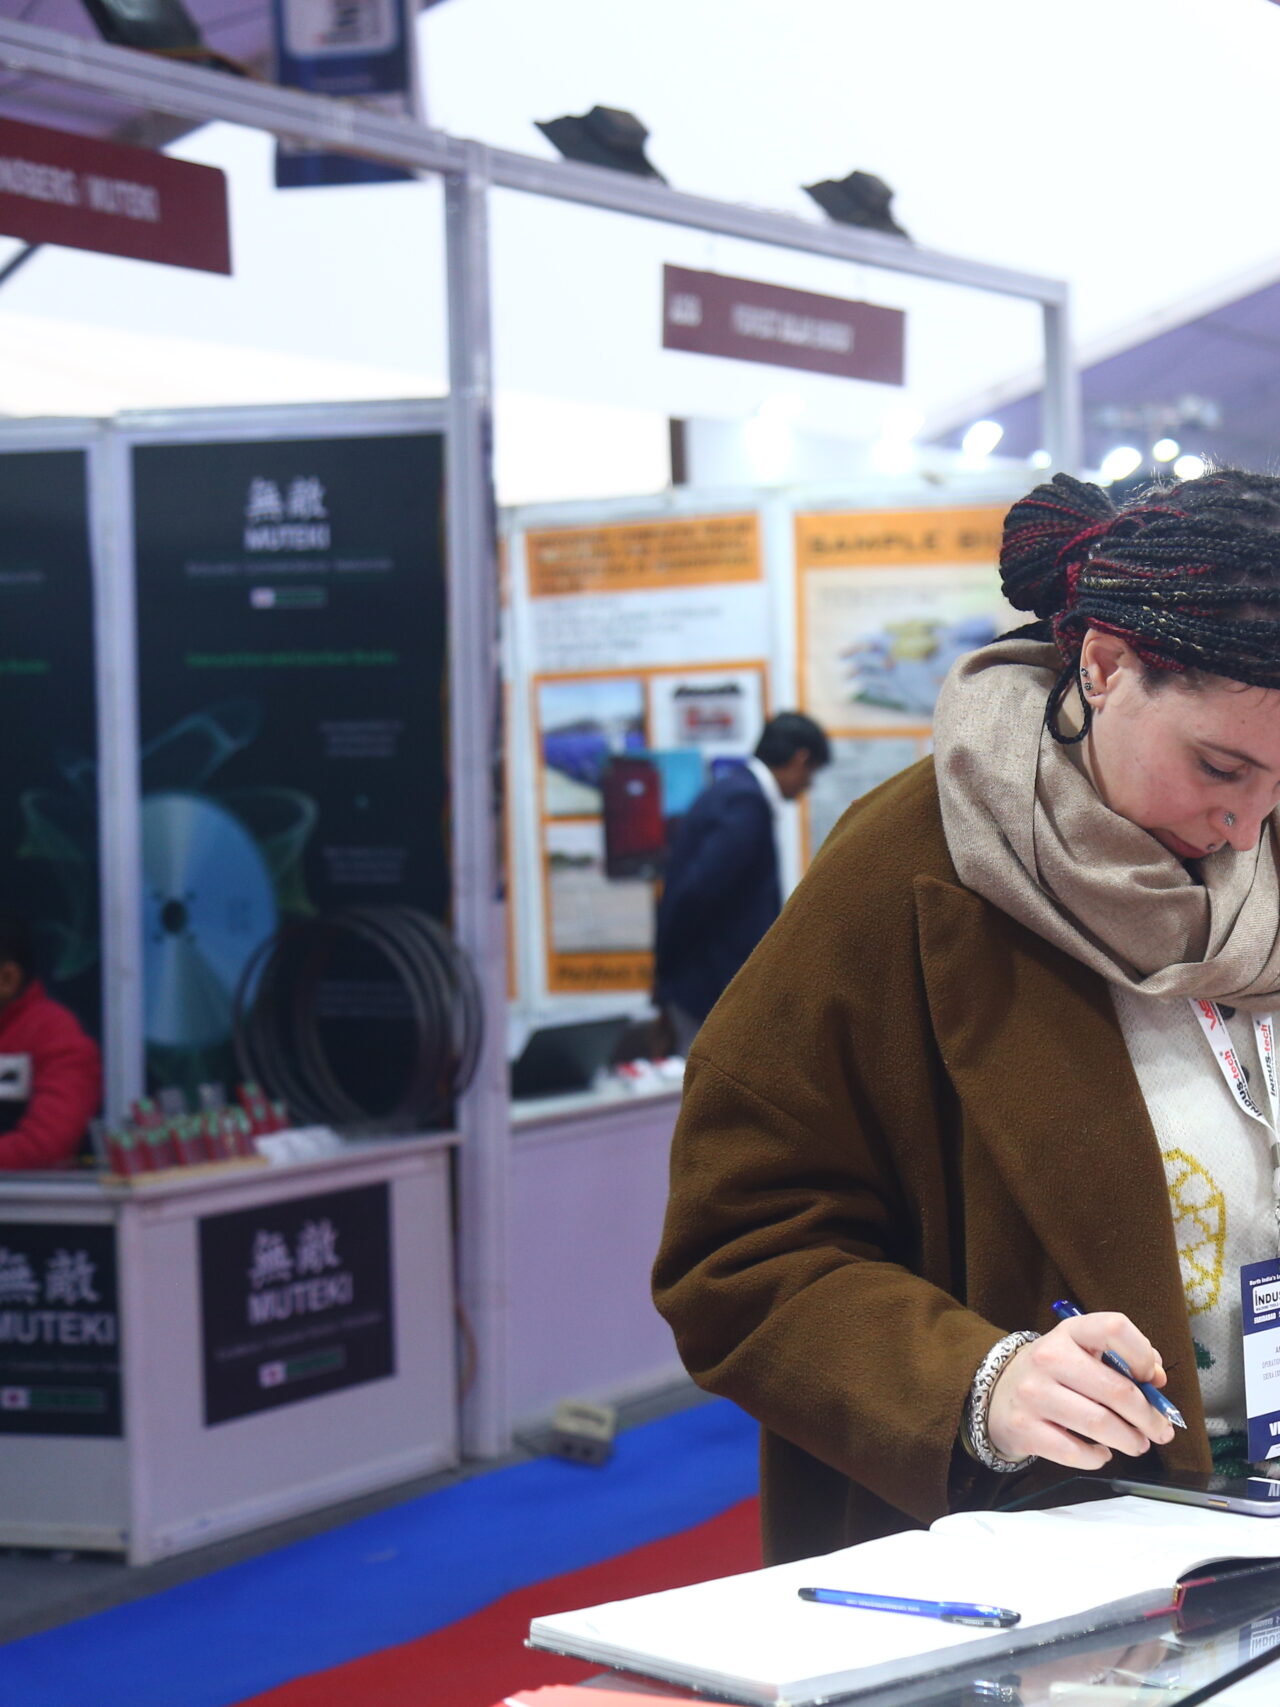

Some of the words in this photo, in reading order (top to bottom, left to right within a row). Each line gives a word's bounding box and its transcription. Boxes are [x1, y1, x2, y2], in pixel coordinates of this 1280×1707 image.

[244, 524, 330, 550] MUTEKI
[808, 531, 938, 553] SAMPLE
[249, 1217, 343, 1289] 無敵
[248, 1272, 353, 1326] MUTEKI
